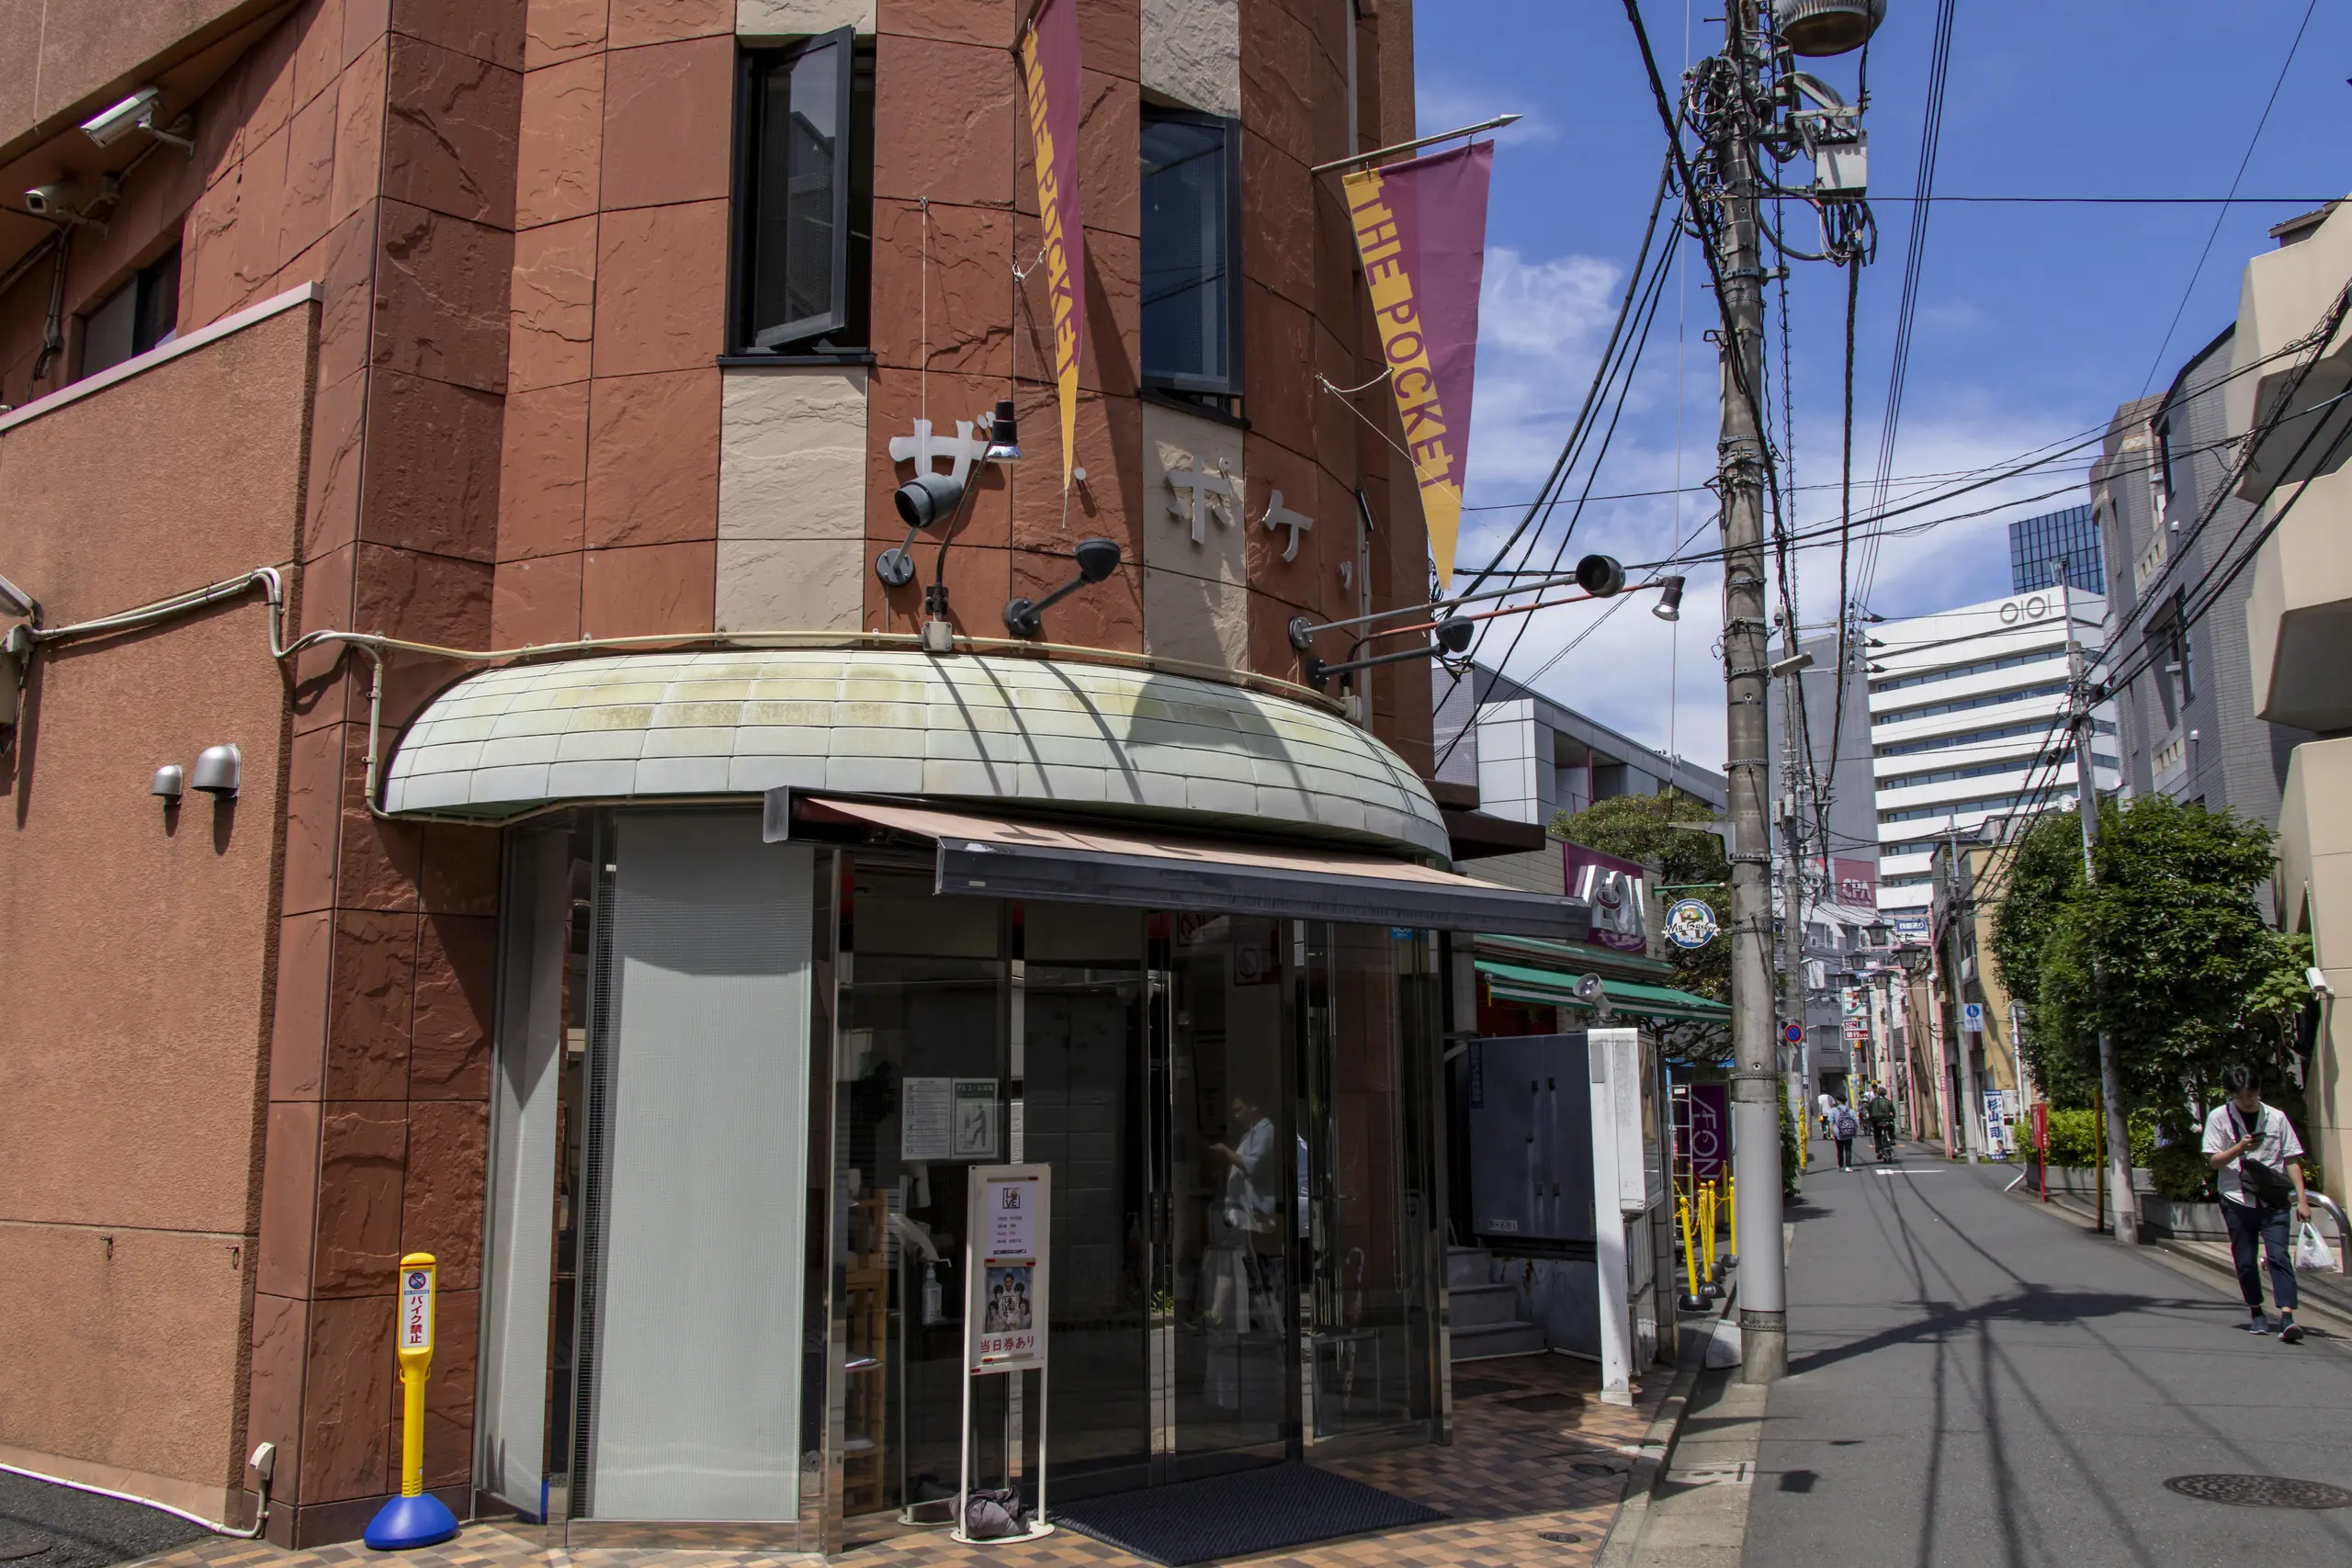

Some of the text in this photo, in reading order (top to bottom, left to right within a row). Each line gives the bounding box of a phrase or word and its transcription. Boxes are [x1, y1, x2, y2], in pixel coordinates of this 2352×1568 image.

[1028, 55, 1078, 378] THE POCKET
[1352, 187, 1460, 488] THE POCKET
[1664, 920, 1717, 935] My Basket
[410, 1295, 423, 1344] バイク禁止
[980, 1335, 1035, 1353] 当日券あり
